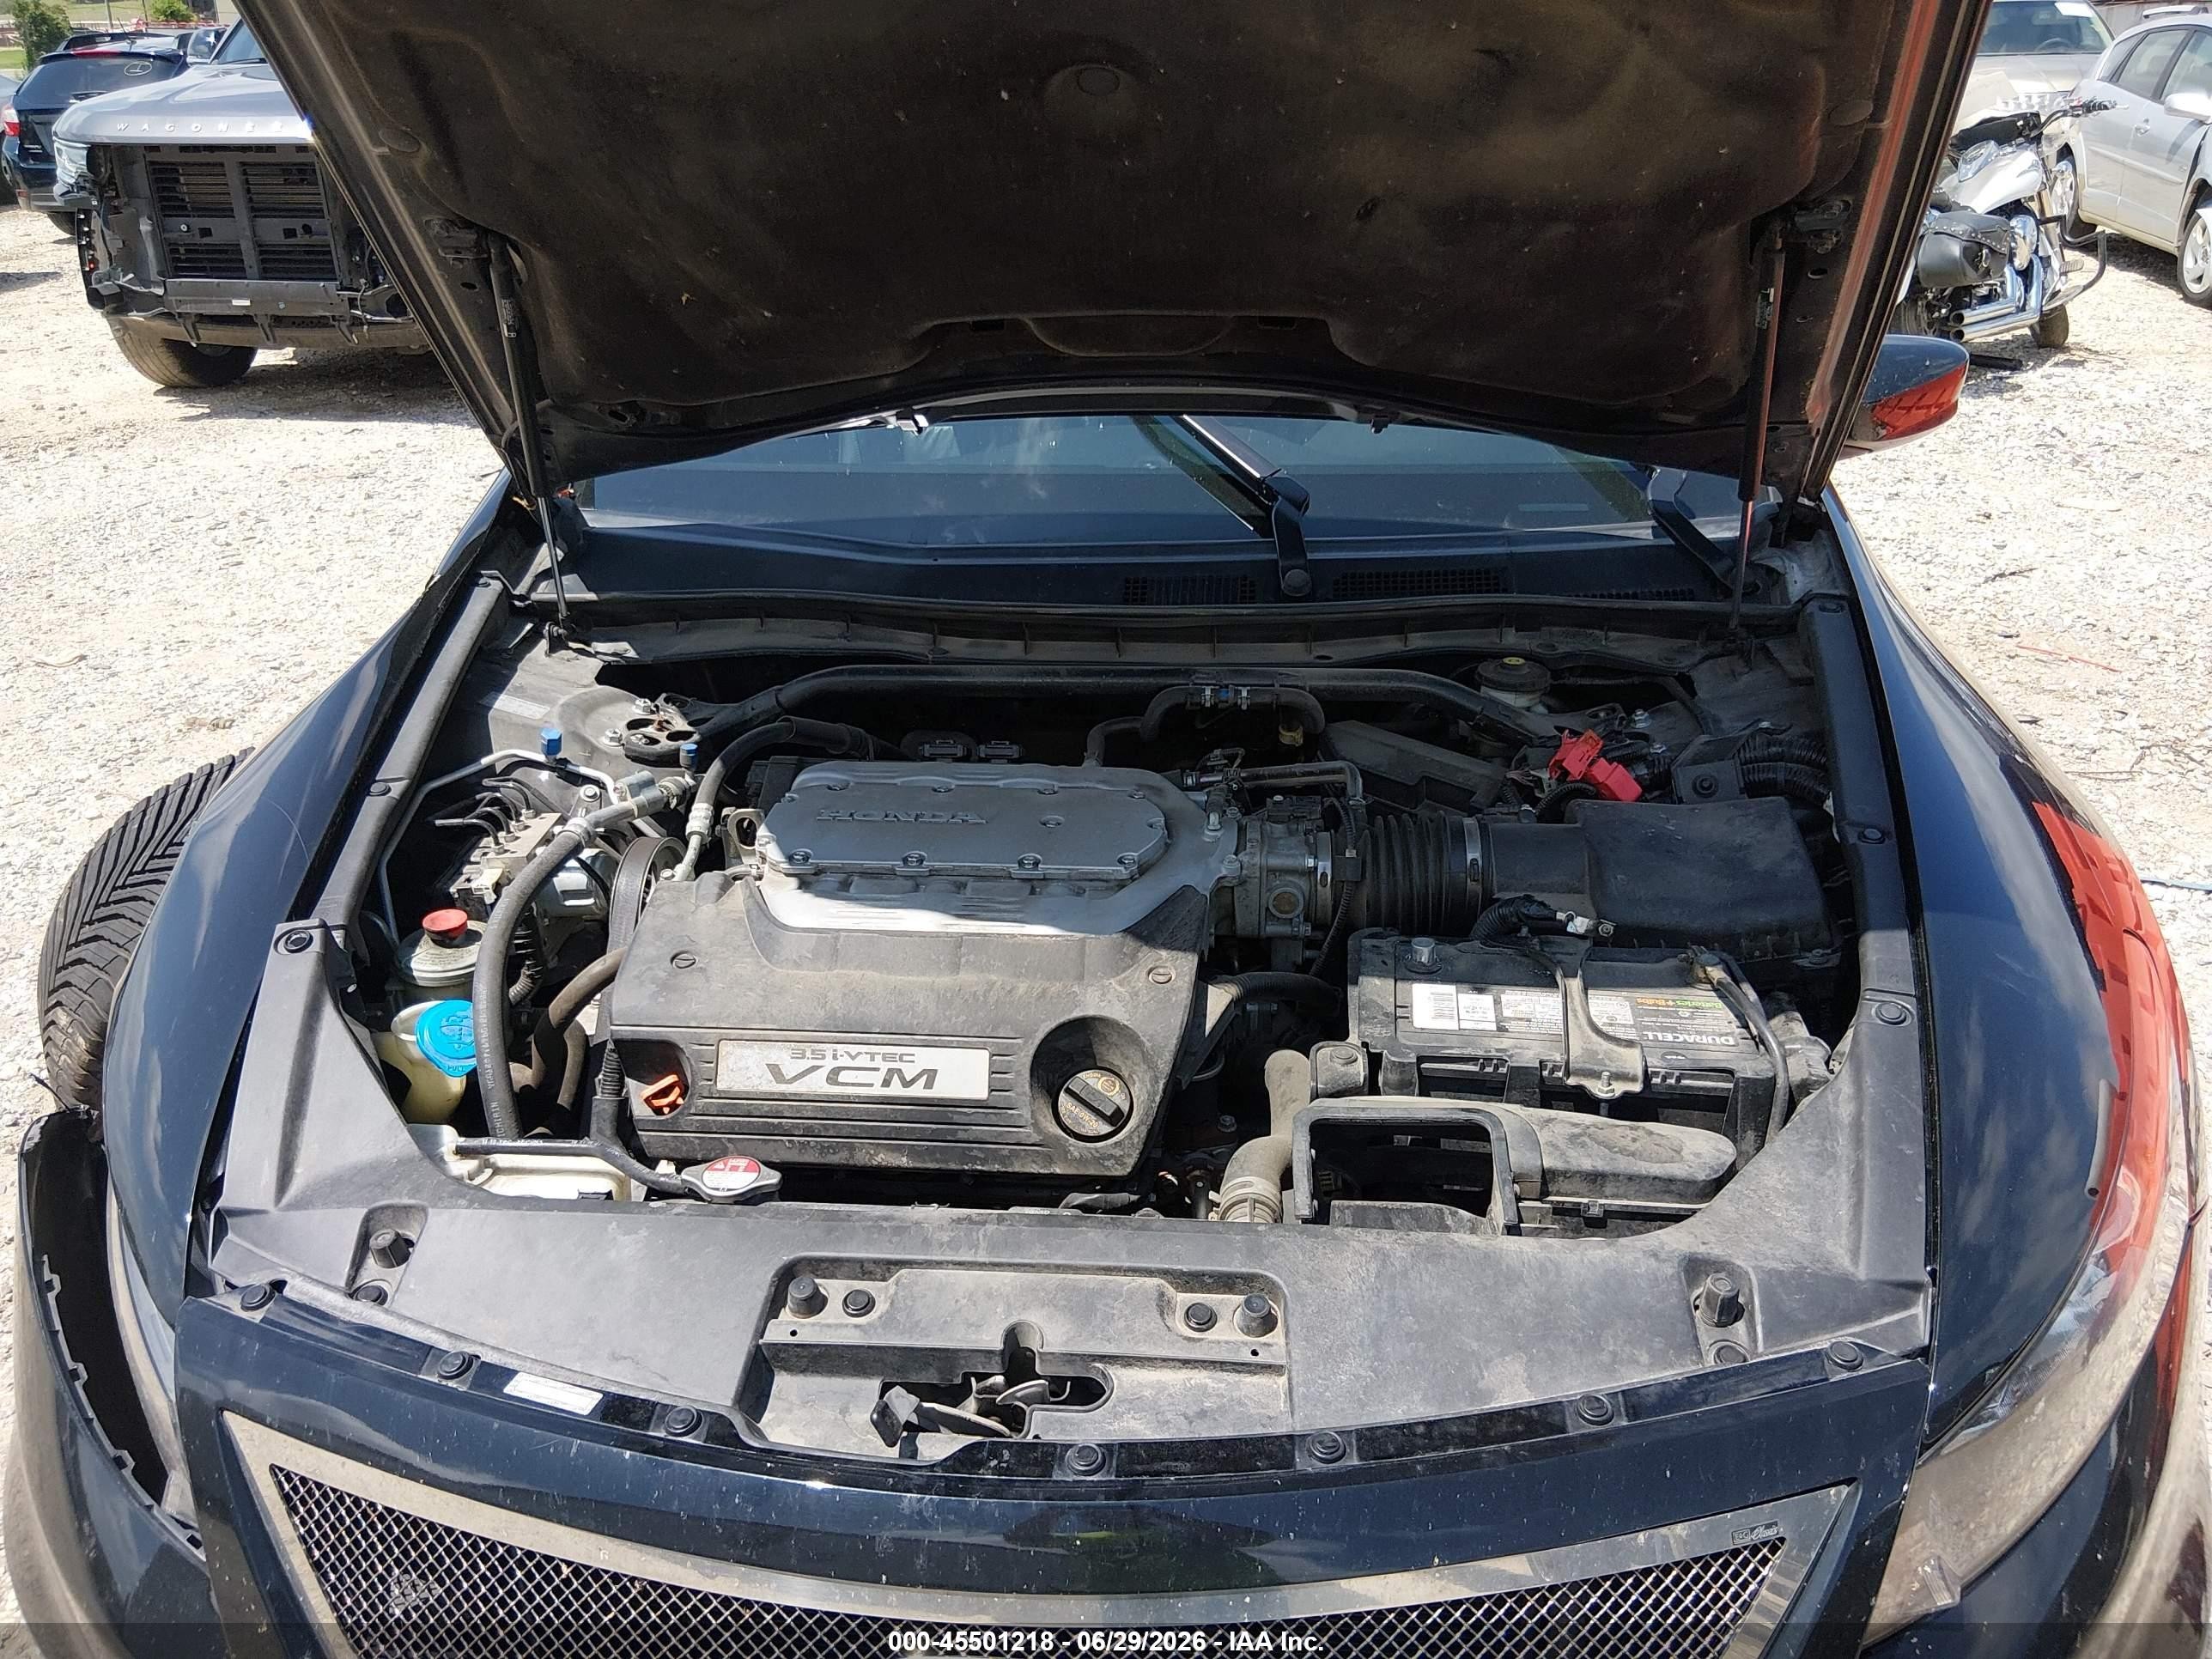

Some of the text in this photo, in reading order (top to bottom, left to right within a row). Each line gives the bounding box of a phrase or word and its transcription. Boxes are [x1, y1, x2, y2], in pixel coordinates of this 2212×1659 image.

[817, 809, 988, 824] HONDA
[1642, 1030, 1735, 1046] DURACELL
[790, 1048, 916, 1064] 3.5 i-VTEC
[765, 1063, 939, 1091] VCM
[1066, 1102, 1080, 1115] SAE
